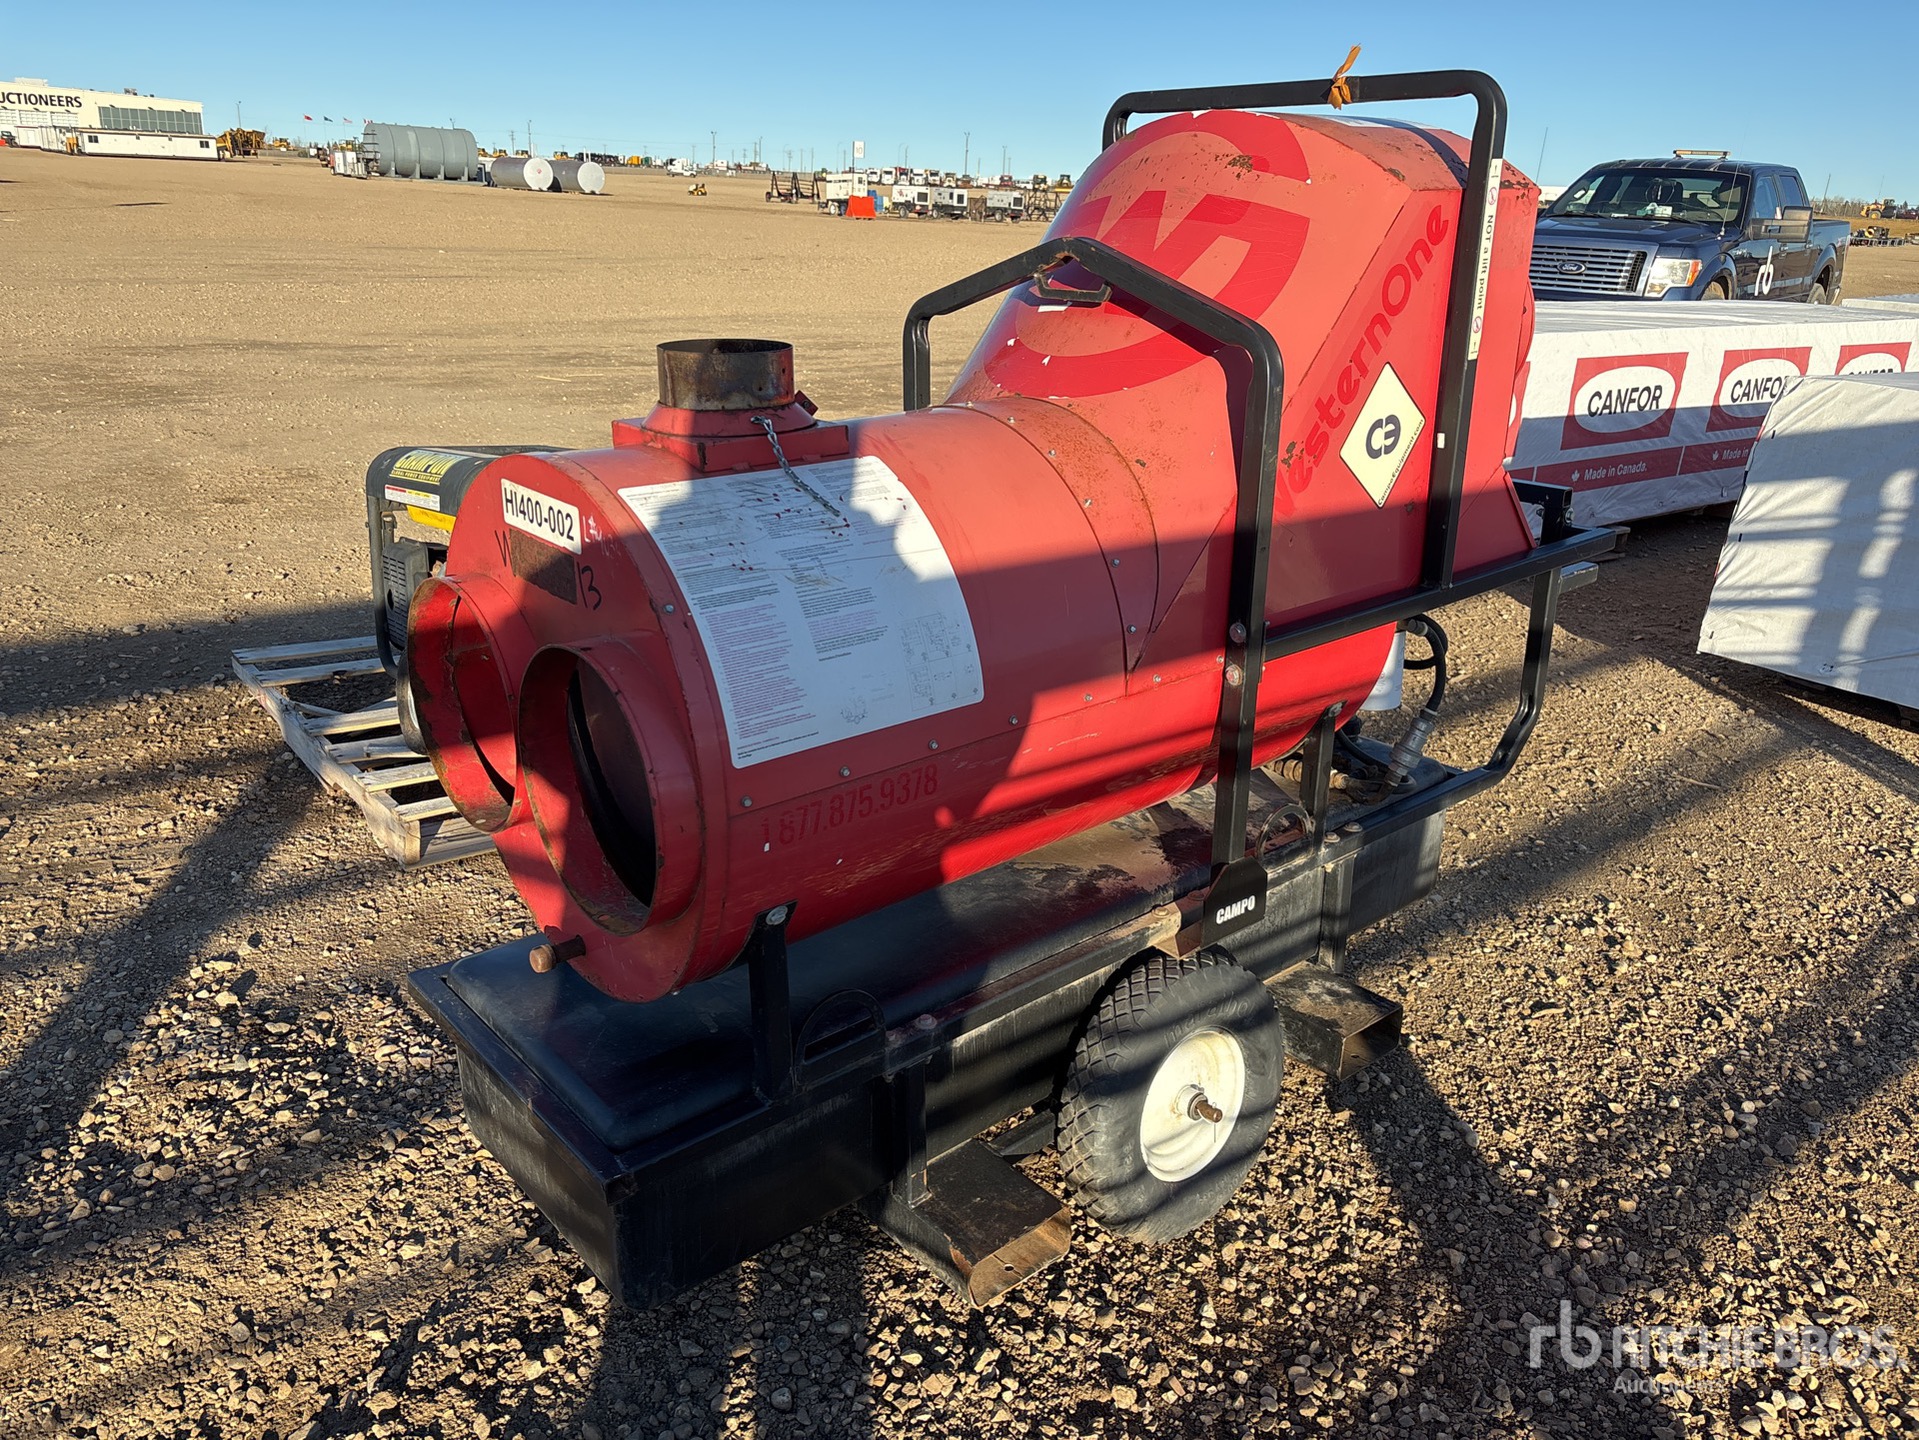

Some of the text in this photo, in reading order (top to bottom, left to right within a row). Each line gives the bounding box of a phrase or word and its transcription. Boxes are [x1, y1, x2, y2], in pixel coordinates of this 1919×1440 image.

[1485, 214, 1494, 242] NOT
[1480, 258, 1488, 273] lift
[1476, 278, 1485, 309] point
[1587, 384, 1663, 418] CANFOR
[1731, 376, 1788, 403] CANFO
[1721, 446, 1749, 460] Made in
[1584, 467, 1607, 480] Made
[1607, 465, 1616, 477] in
[504, 487, 574, 541] HI400-002
[1216, 895, 1256, 925] CAMPO
